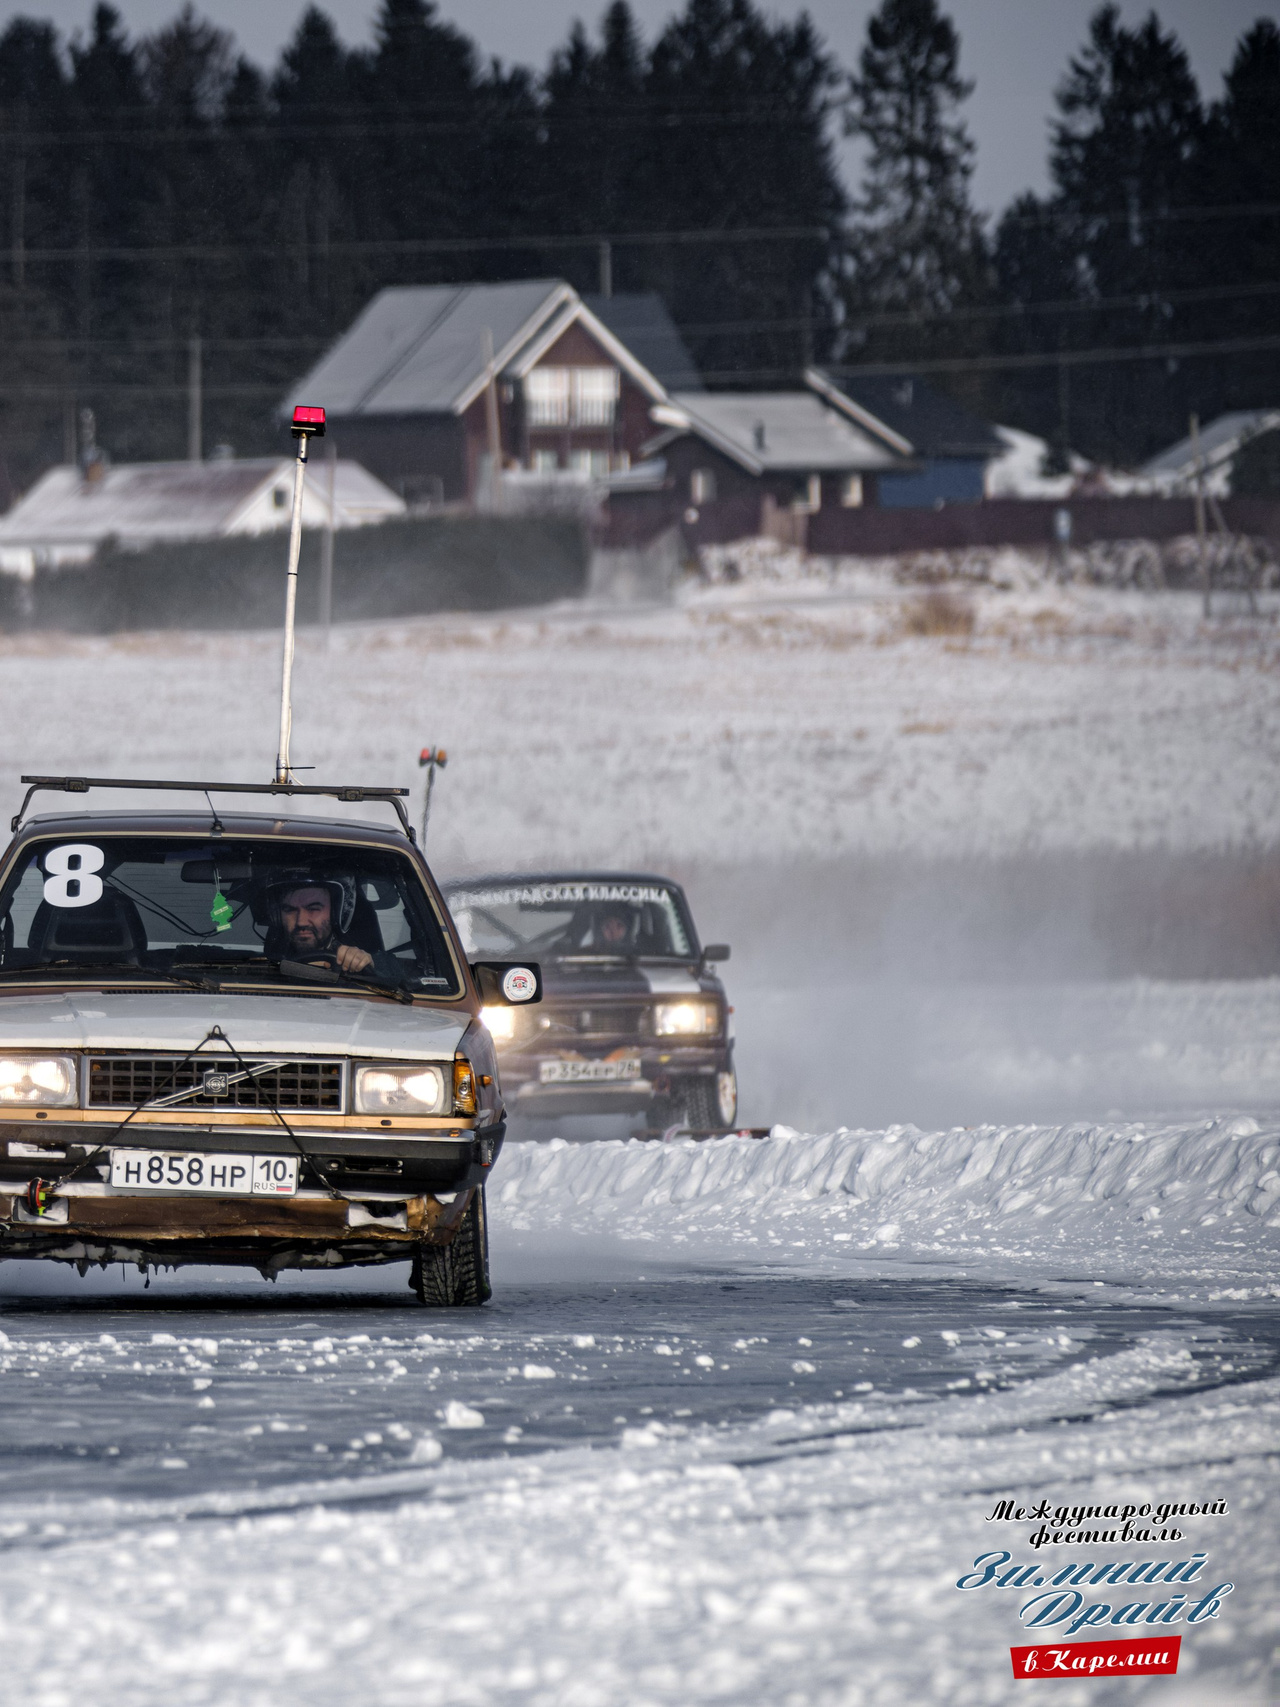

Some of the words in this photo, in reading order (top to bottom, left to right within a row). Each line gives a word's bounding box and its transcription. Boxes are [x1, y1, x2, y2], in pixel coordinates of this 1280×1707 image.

[43, 843, 105, 908] 8
[589, 886, 670, 902] КЛАССИКА
[125, 1156, 246, 1188] Н858НР
[259, 1159, 287, 1182] 10
[254, 1182, 276, 1191] RUS
